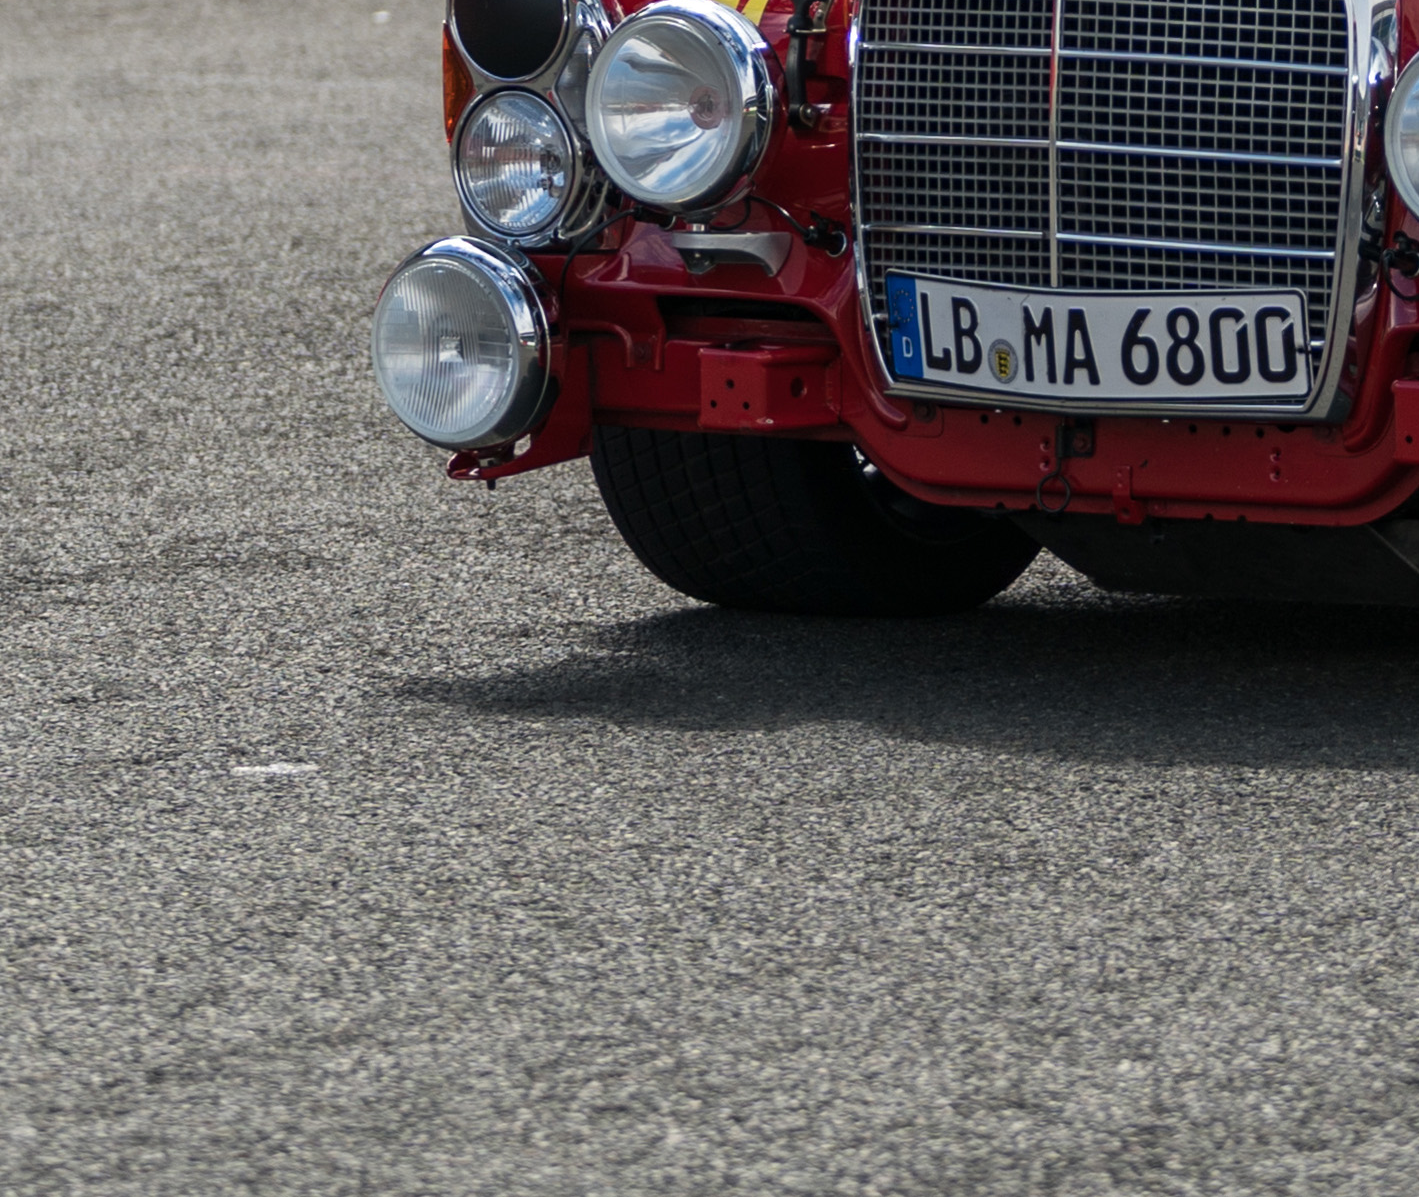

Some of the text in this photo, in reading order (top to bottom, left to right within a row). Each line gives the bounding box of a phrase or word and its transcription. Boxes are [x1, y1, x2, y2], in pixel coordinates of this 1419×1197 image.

[901, 336, 914, 359] D
[920, 291, 1299, 386] LB MA 6800
